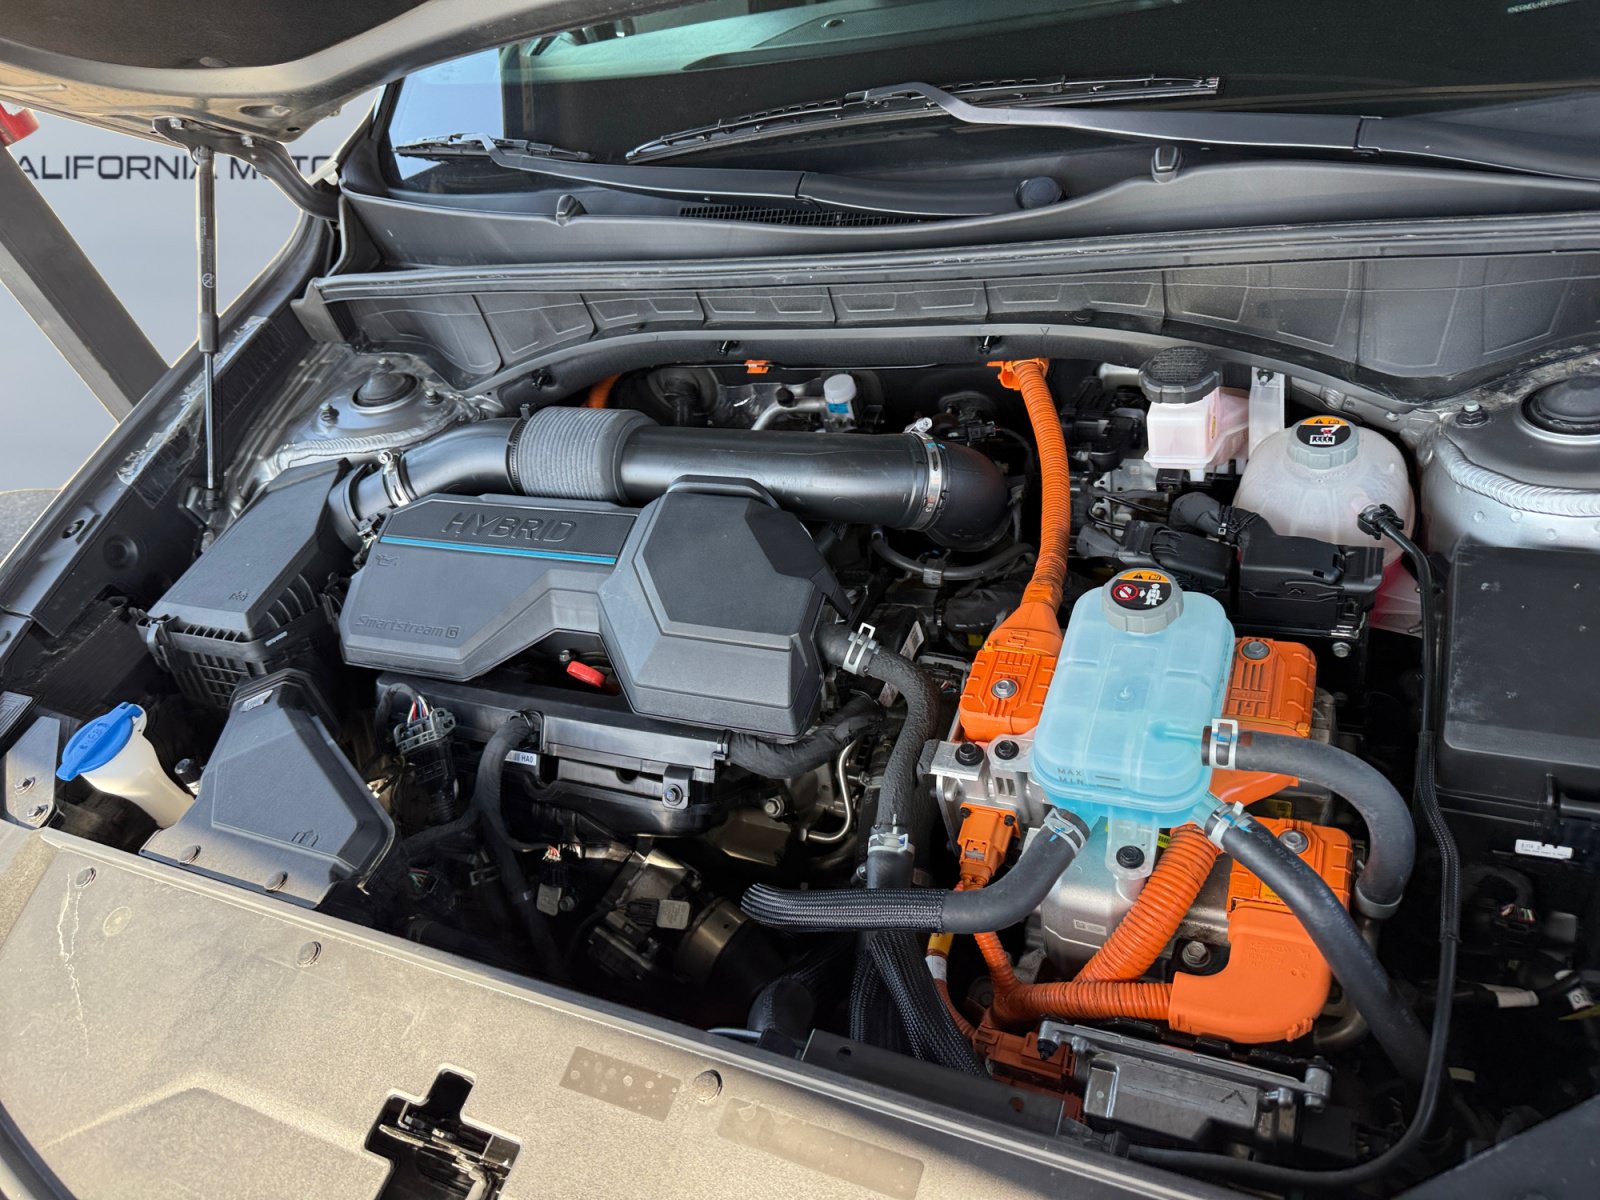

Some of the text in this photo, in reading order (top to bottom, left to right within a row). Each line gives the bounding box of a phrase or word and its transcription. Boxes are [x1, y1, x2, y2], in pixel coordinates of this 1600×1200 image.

[441, 511, 577, 542] HYBRID
[355, 615, 443, 637] Smartstream
[1057, 767, 1082, 777] MAX
